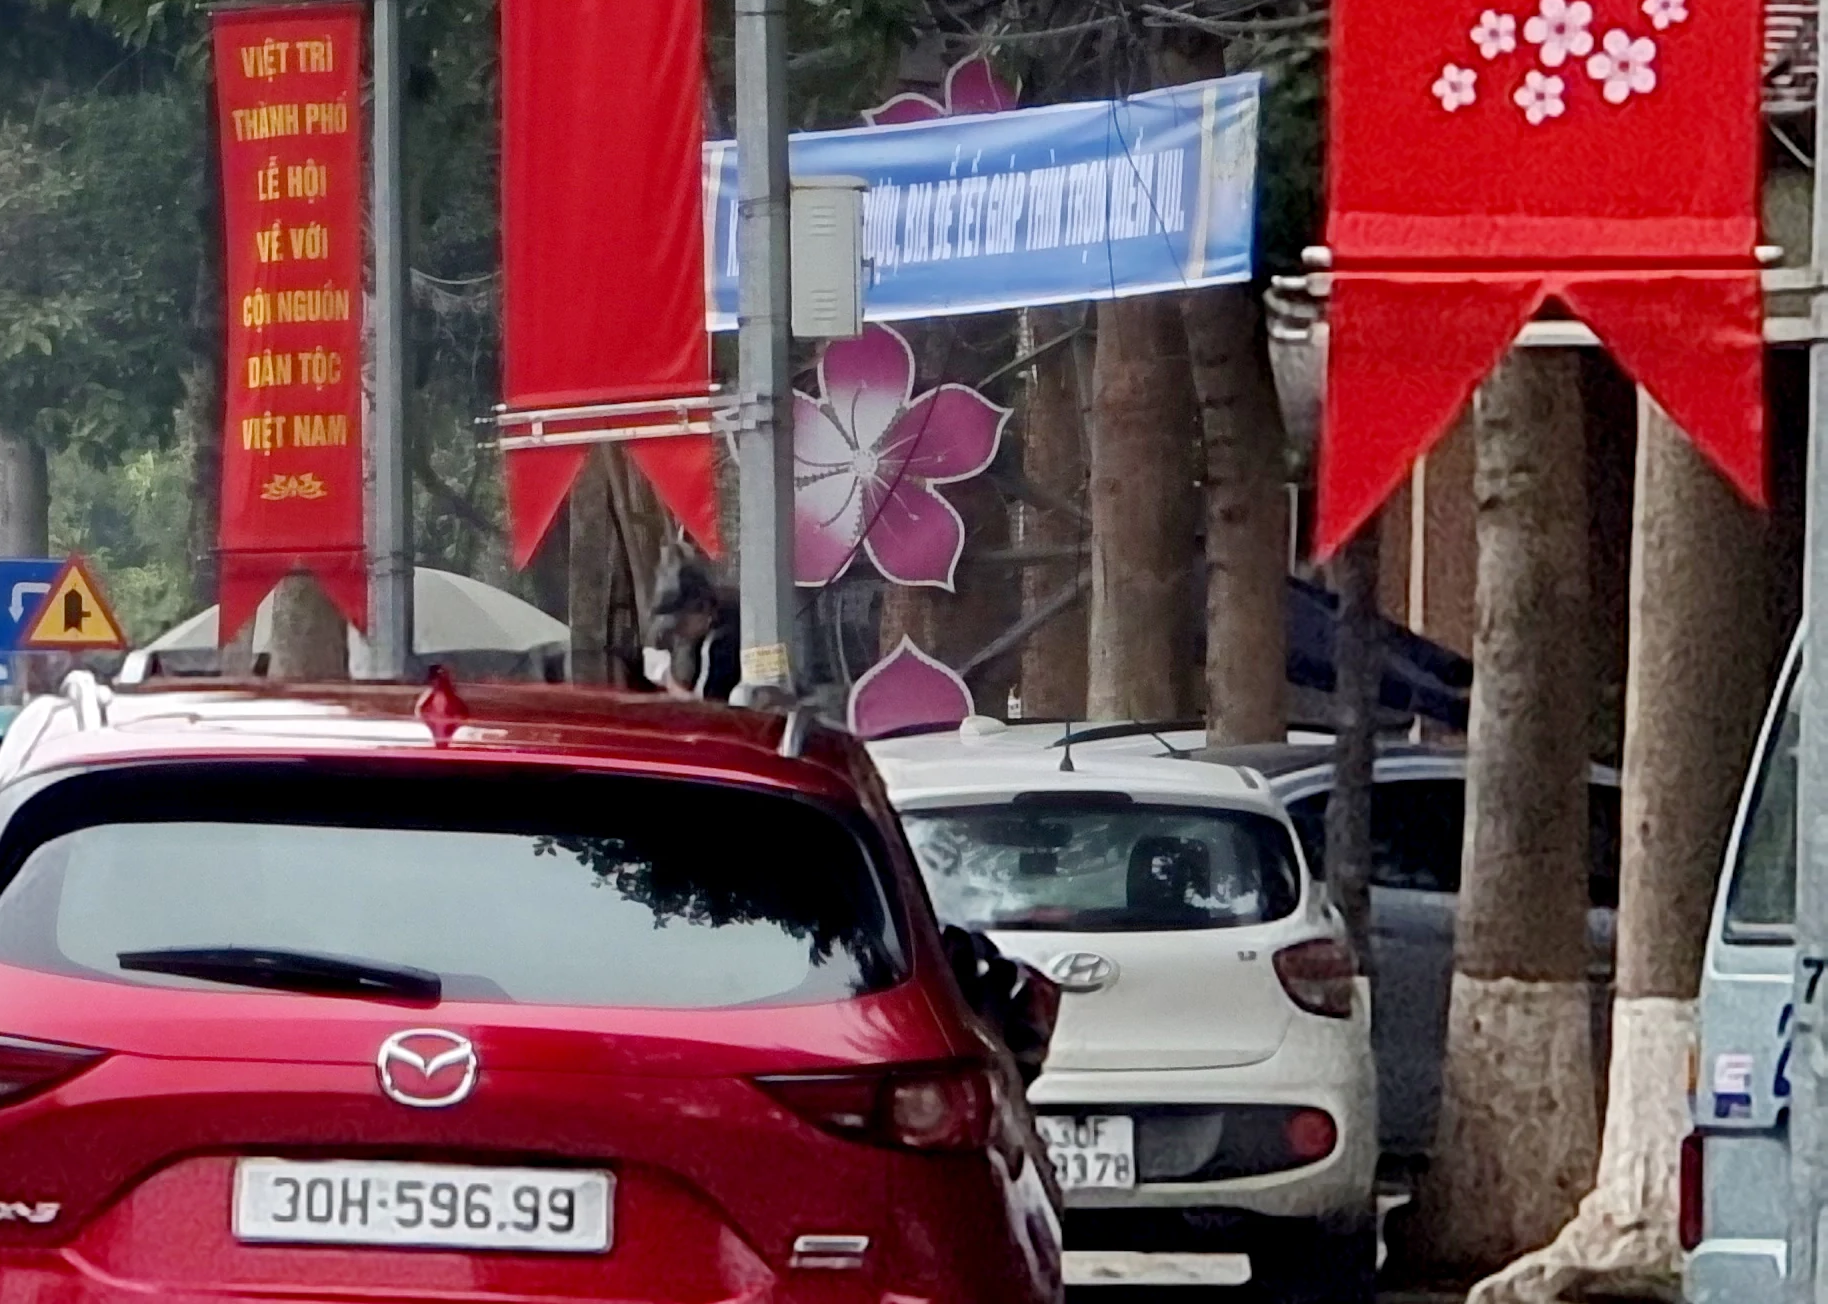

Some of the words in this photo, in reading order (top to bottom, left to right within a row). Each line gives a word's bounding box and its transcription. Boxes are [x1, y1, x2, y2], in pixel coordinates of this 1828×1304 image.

[240, 36, 290, 83] VIỆT
[295, 33, 333, 73] TRÌ
[232, 100, 299, 142] THÀNH
[305, 90, 348, 135] PHỐ
[257, 155, 280, 202] LỄ
[287, 157, 327, 205] HỘI
[903, 181, 933, 264] BIA
[956, 148, 988, 259] TẾT
[985, 153, 1027, 256] GIÁP
[1025, 148, 1067, 252] THÌN
[256, 218, 284, 263] VỀ
[289, 220, 329, 260] VỚI
[243, 286, 272, 334] CỘI
[277, 278, 350, 323] NGUỒN
[248, 348, 292, 389] DÂN
[298, 344, 342, 392] TỘC
[242, 410, 287, 457] VIỆT
[293, 414, 347, 448] NAM
